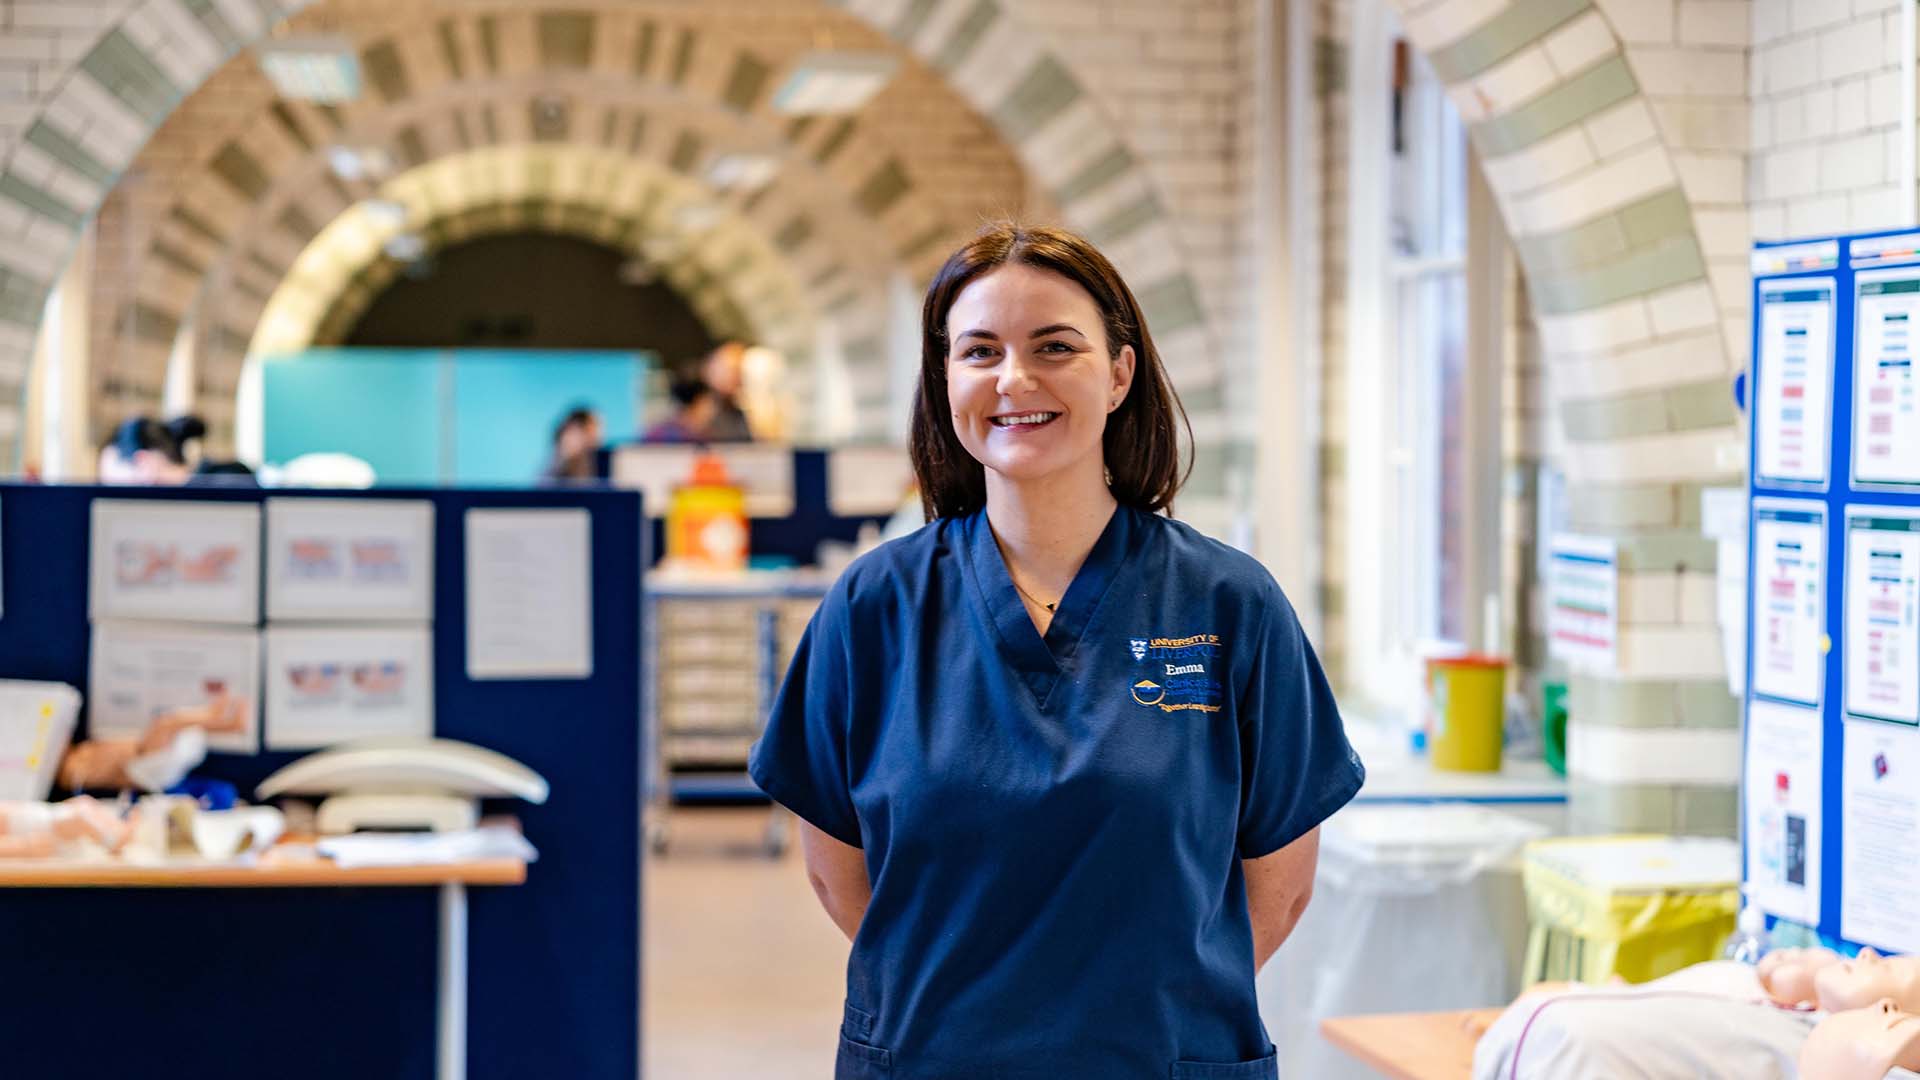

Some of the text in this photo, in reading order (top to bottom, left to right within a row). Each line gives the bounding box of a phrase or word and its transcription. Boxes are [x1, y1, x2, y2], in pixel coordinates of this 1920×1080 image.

[1150, 634, 1206, 646] UNIVERSITY
[1151, 645, 1221, 659] LIVERPO
[1165, 664, 1205, 676] Emma
